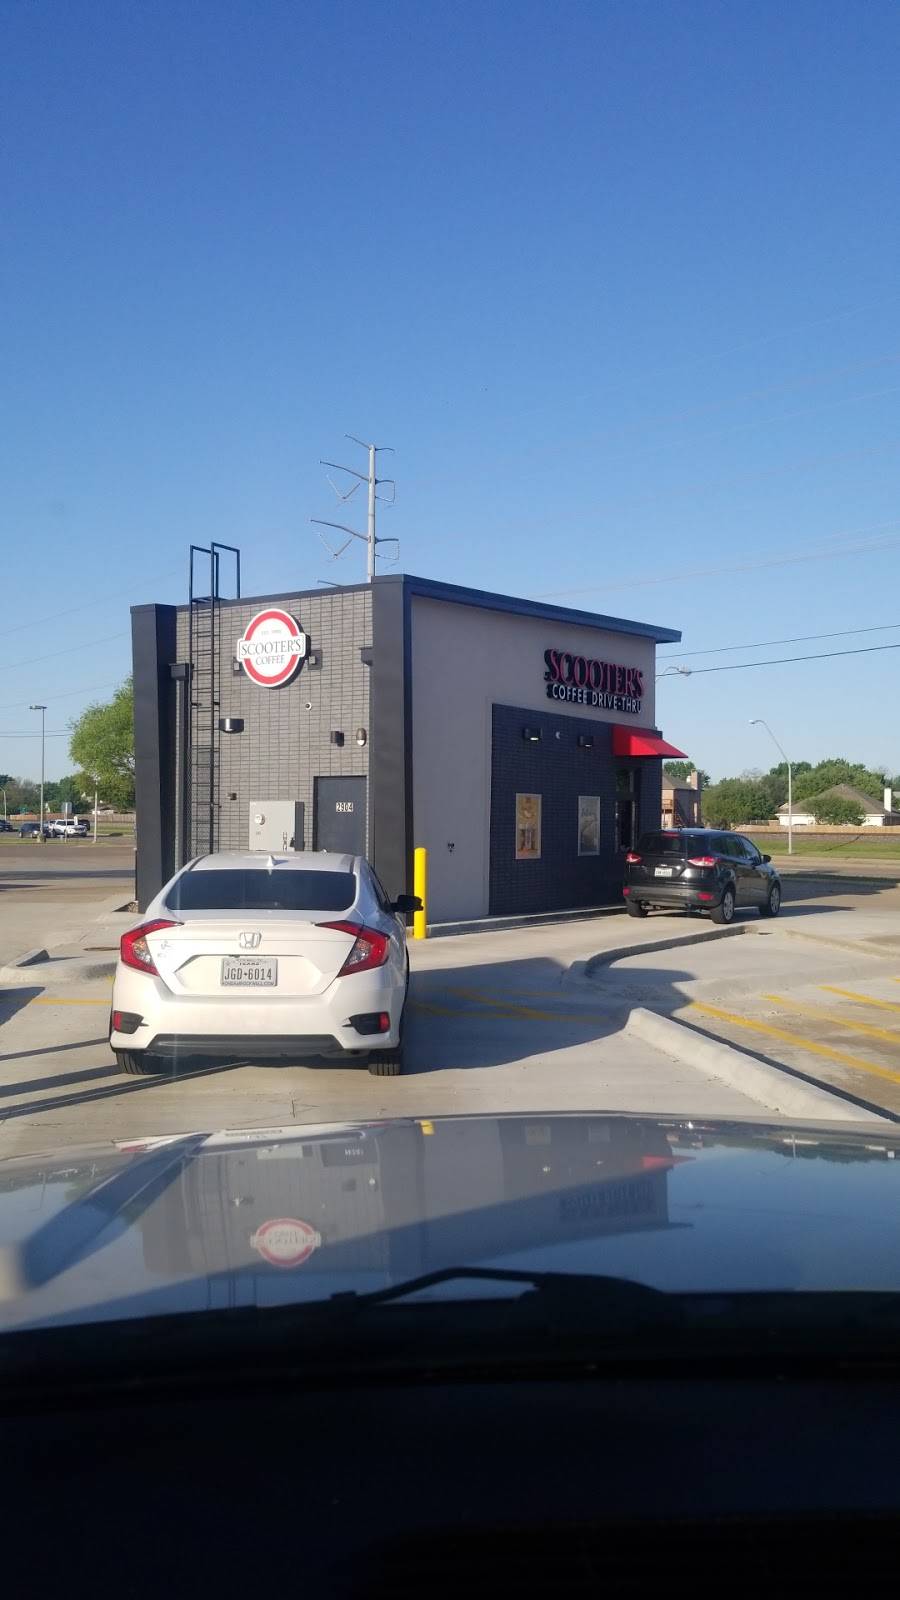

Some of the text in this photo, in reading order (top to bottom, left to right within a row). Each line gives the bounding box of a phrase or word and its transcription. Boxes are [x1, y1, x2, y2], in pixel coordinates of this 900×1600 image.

[241, 639, 301, 656] SCOOTER'S
[256, 655, 285, 666] COFFEE
[544, 649, 644, 698] SCOOTER'S
[552, 684, 587, 704] COFFEE
[336, 802, 353, 812] 2904
